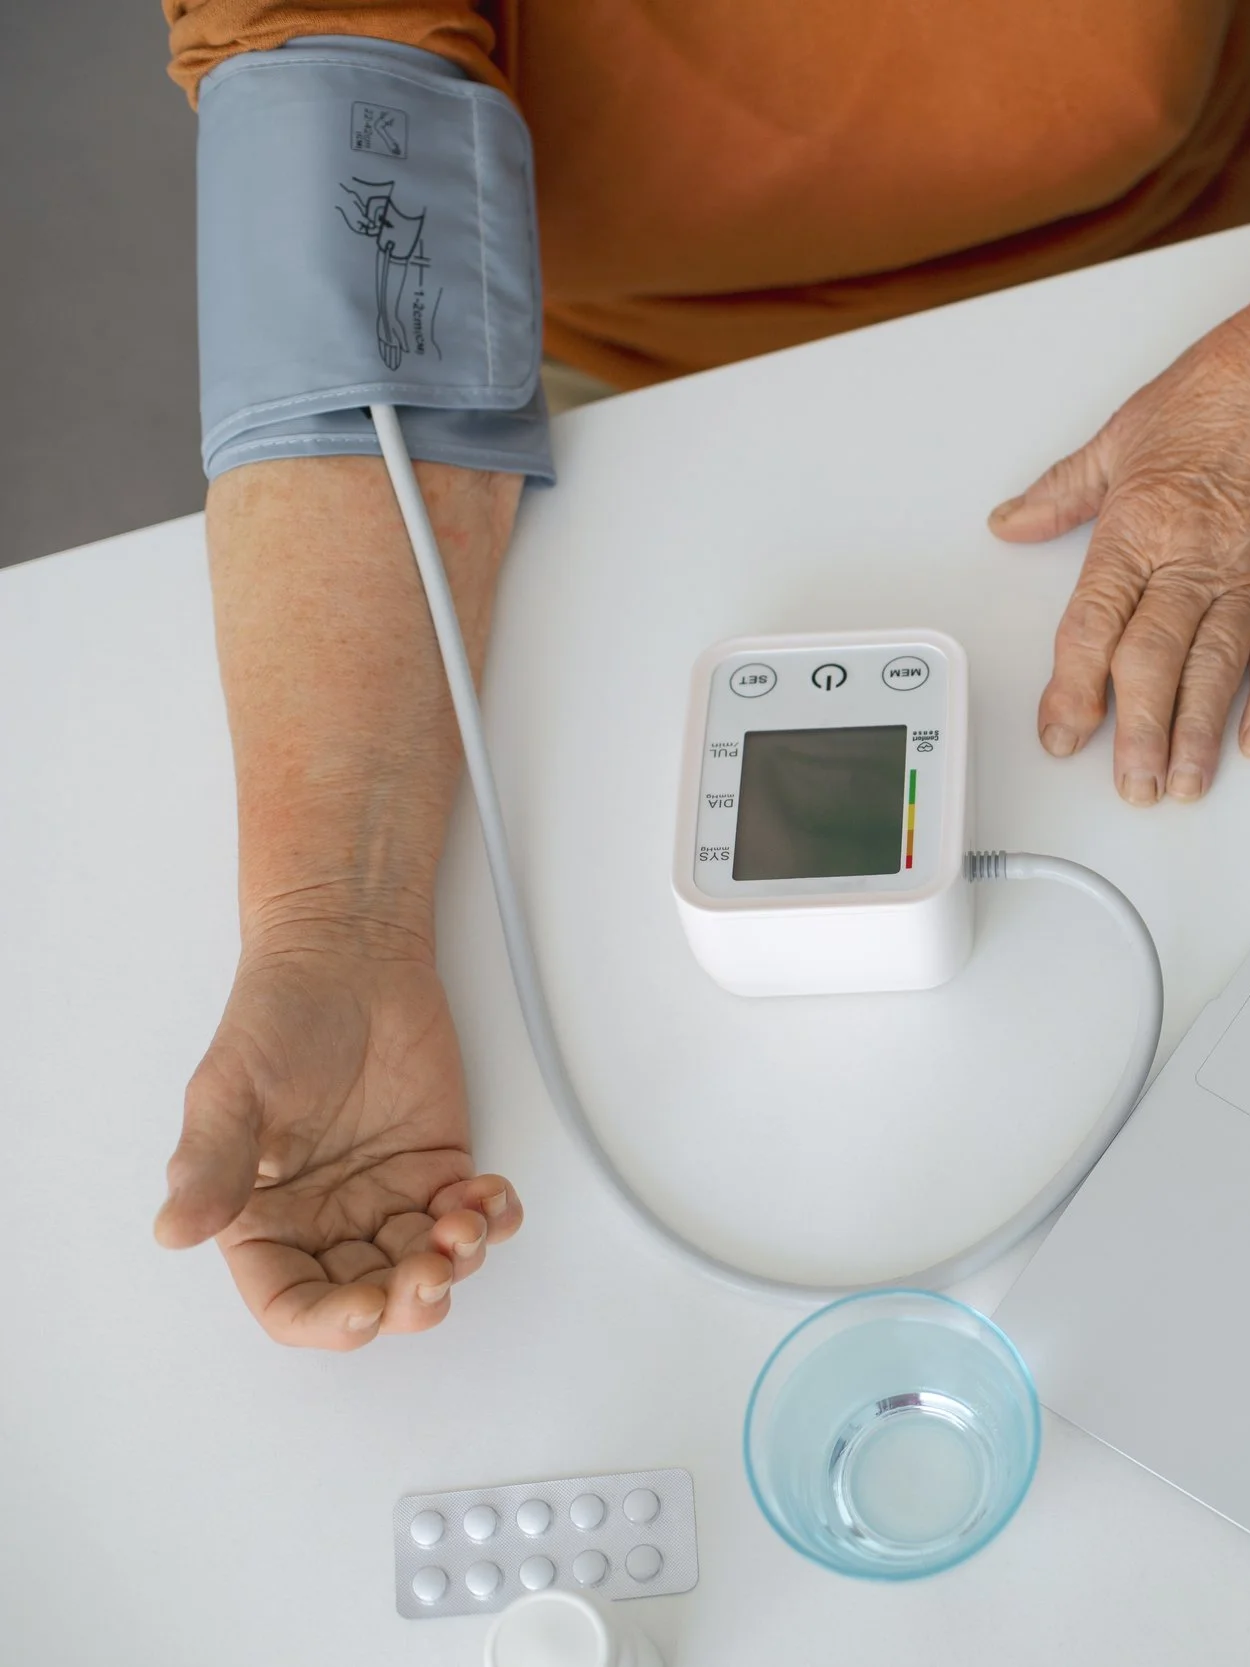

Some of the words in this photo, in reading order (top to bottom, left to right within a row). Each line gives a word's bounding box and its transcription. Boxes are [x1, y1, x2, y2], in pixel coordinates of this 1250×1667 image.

[890, 668, 922, 677] MEM
[739, 675, 768, 685] SET
[709, 748, 738, 759] PUL
[708, 799, 734, 809] DIA
[699, 851, 730, 861] SYS
